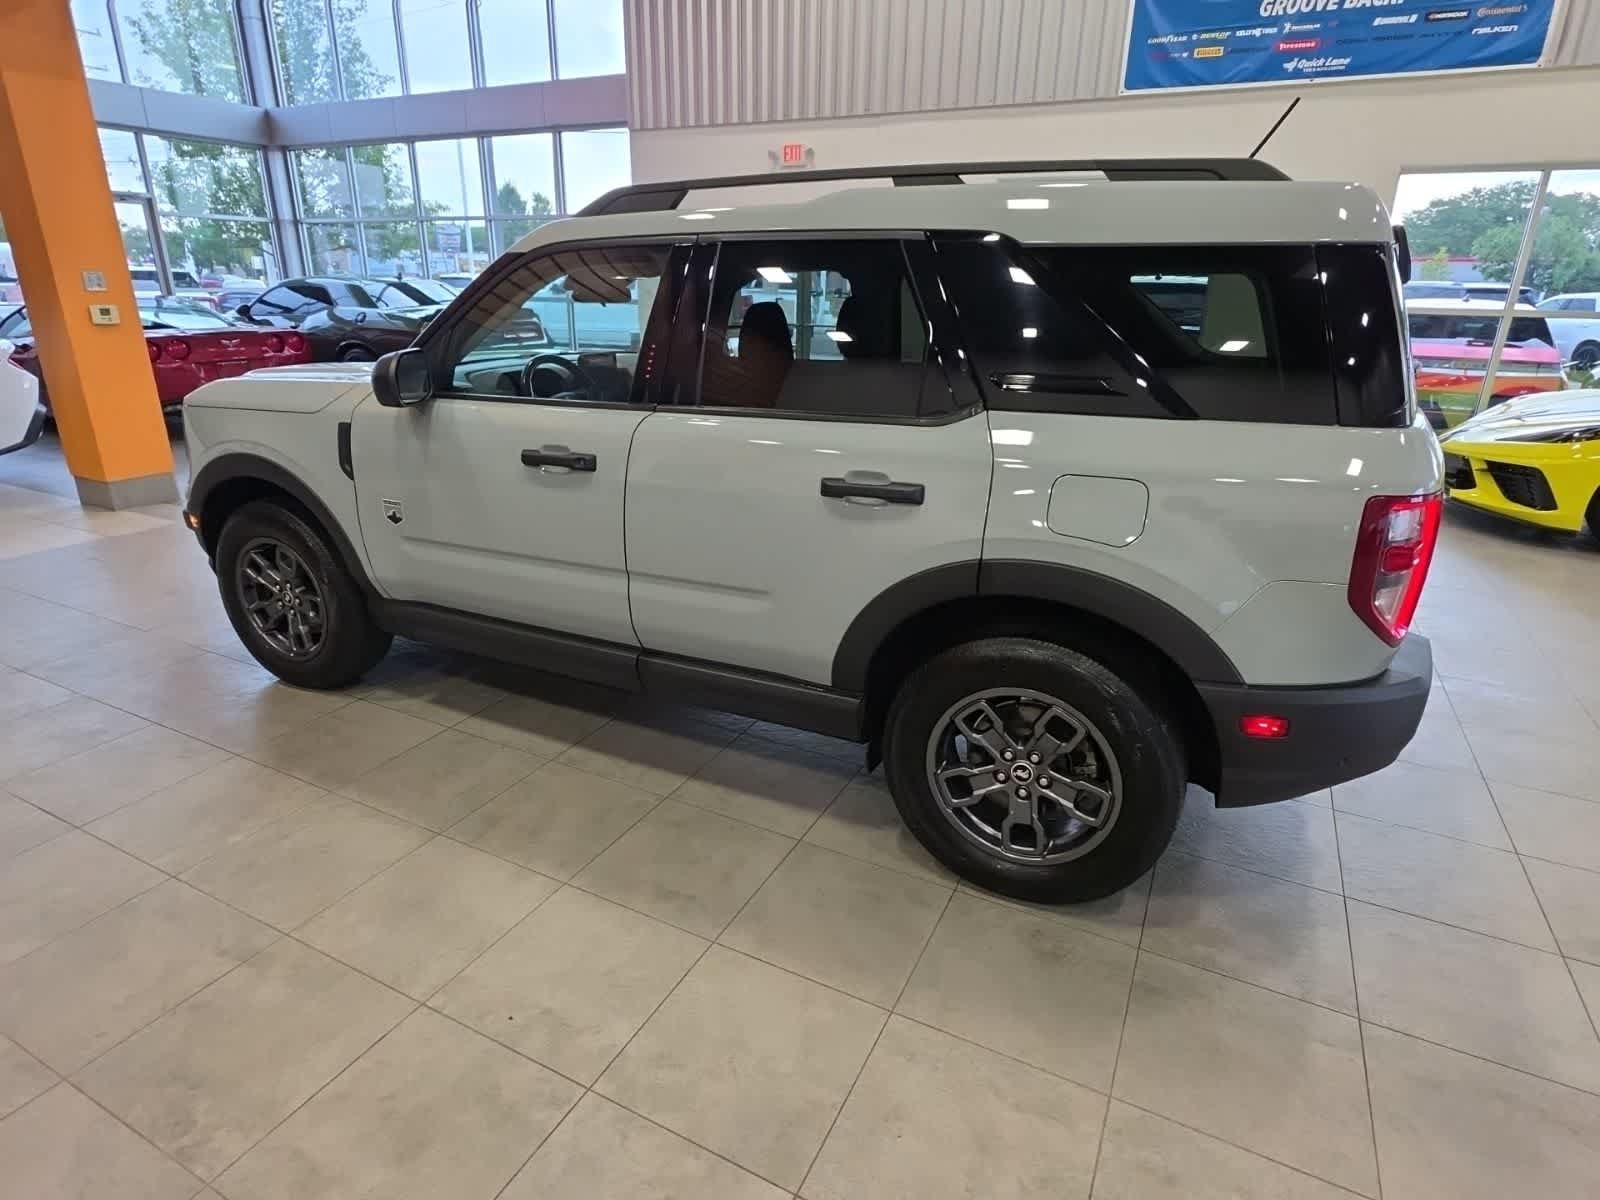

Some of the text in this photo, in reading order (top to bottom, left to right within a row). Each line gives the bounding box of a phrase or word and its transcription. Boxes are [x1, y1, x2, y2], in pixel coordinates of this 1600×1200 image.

[1260, 0, 1341, 17] GROOVE
[1297, 57, 1325, 69] Quick
[784, 145, 803, 161] EXIT
